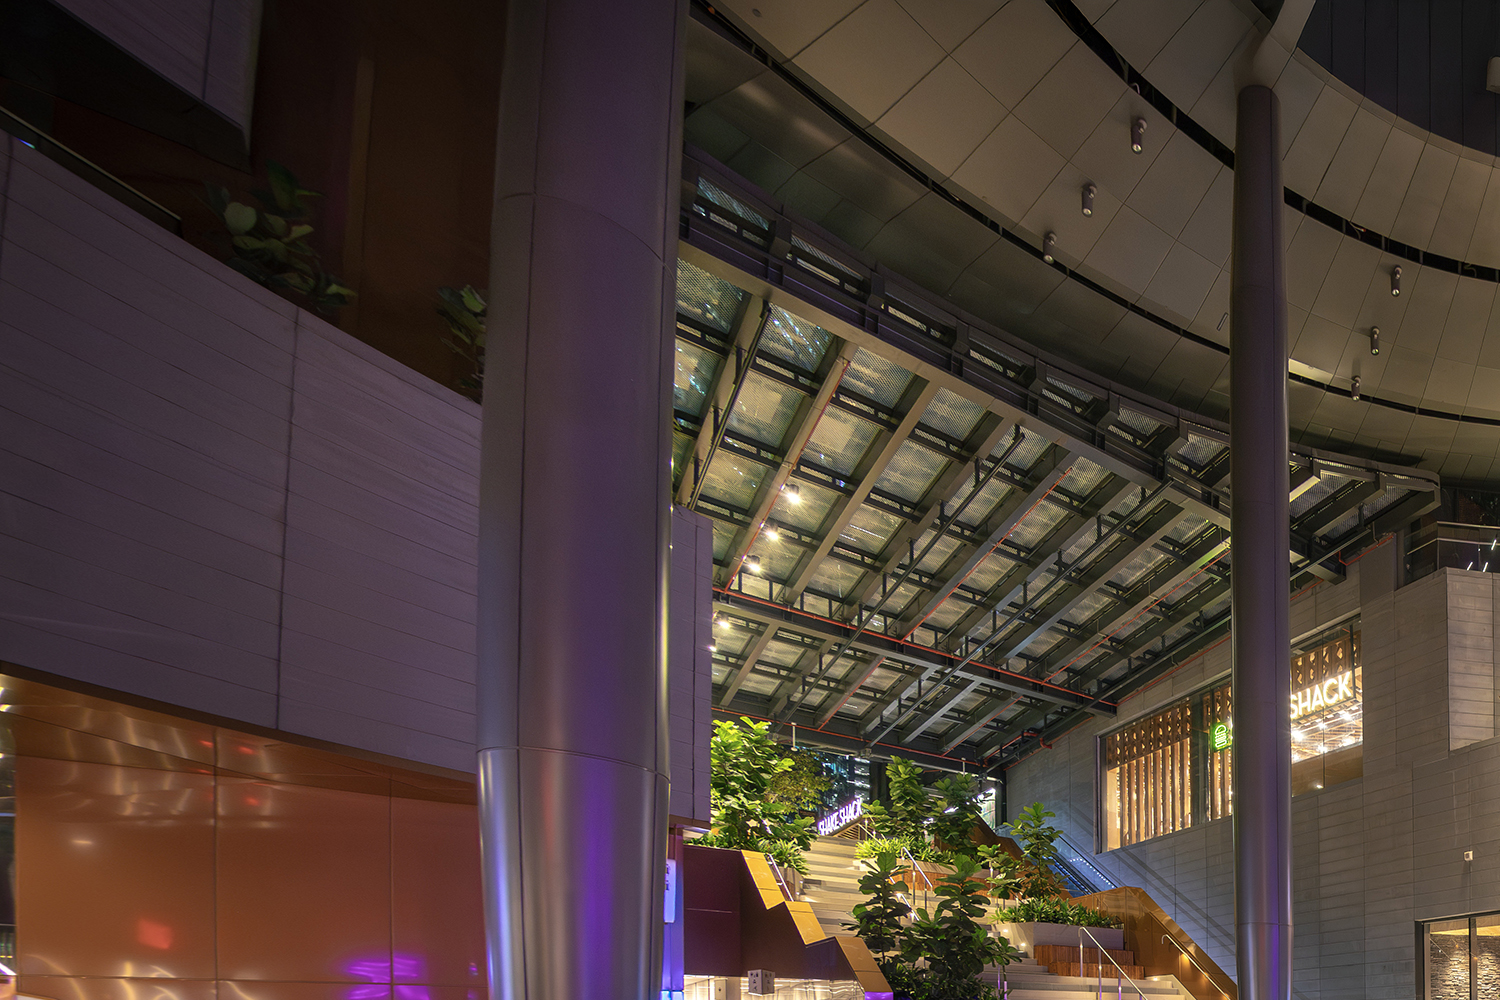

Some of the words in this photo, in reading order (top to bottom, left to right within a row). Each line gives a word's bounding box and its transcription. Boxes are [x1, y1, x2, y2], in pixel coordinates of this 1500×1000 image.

[1290, 671, 1352, 719] SHACK
[818, 811, 840, 836] SHAKE
[839, 798, 863, 826] SHACK
